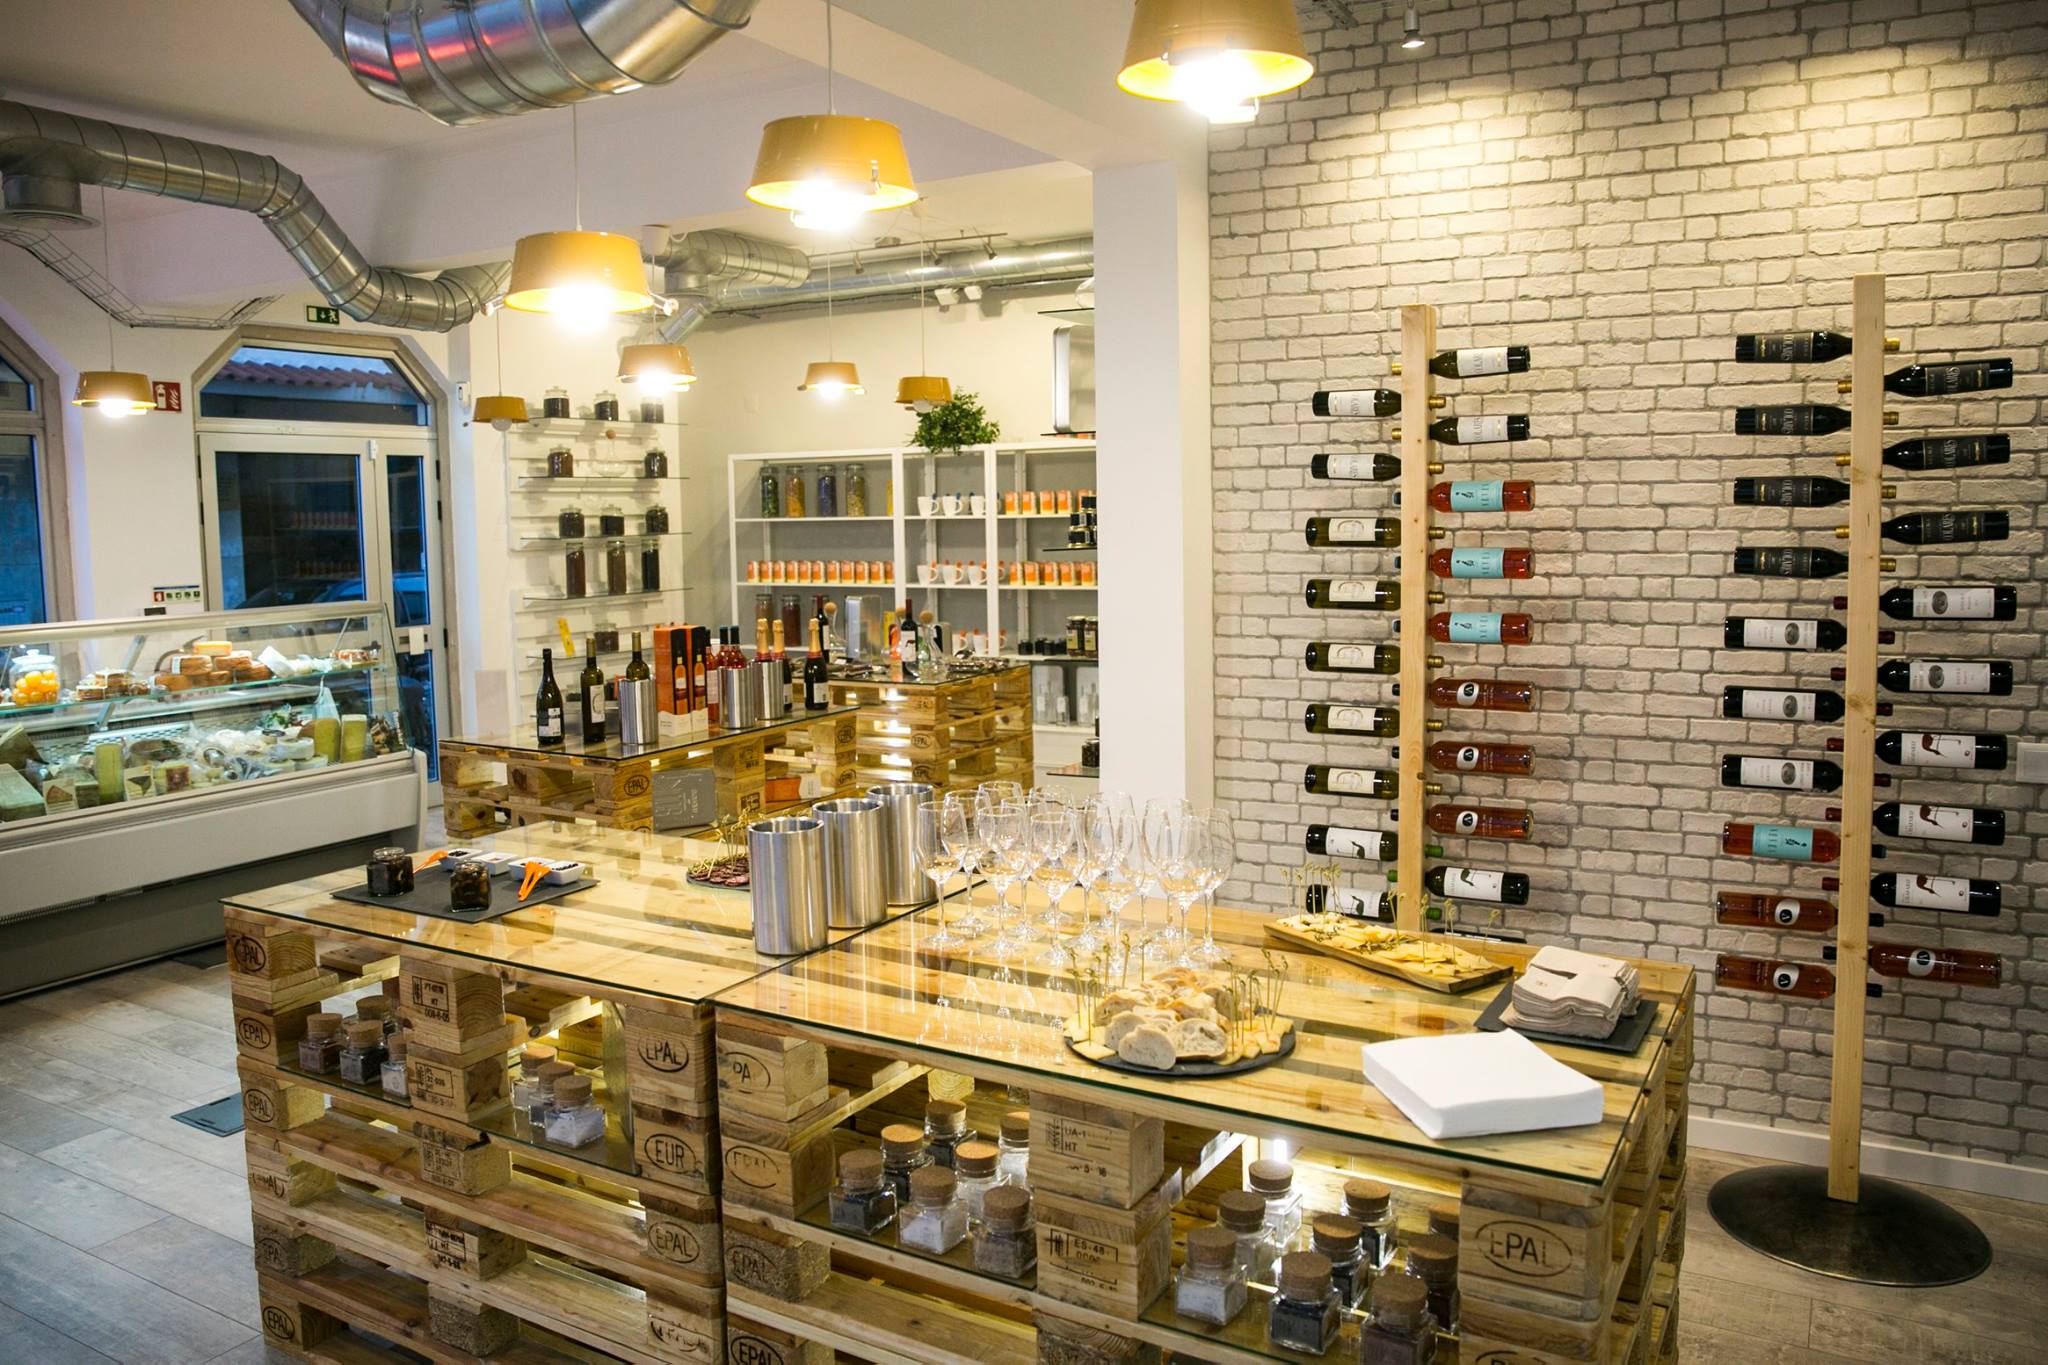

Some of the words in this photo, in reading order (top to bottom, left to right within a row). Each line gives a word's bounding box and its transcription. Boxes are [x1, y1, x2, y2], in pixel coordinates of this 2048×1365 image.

[243, 1017, 267, 1044] EPAL
[249, 1094, 270, 1118] EPAL
[655, 1140, 685, 1169] EUR
[656, 1227, 692, 1258] EPAL
[1490, 1230, 1556, 1269] EPAL
[268, 1310, 292, 1335] EPAL
